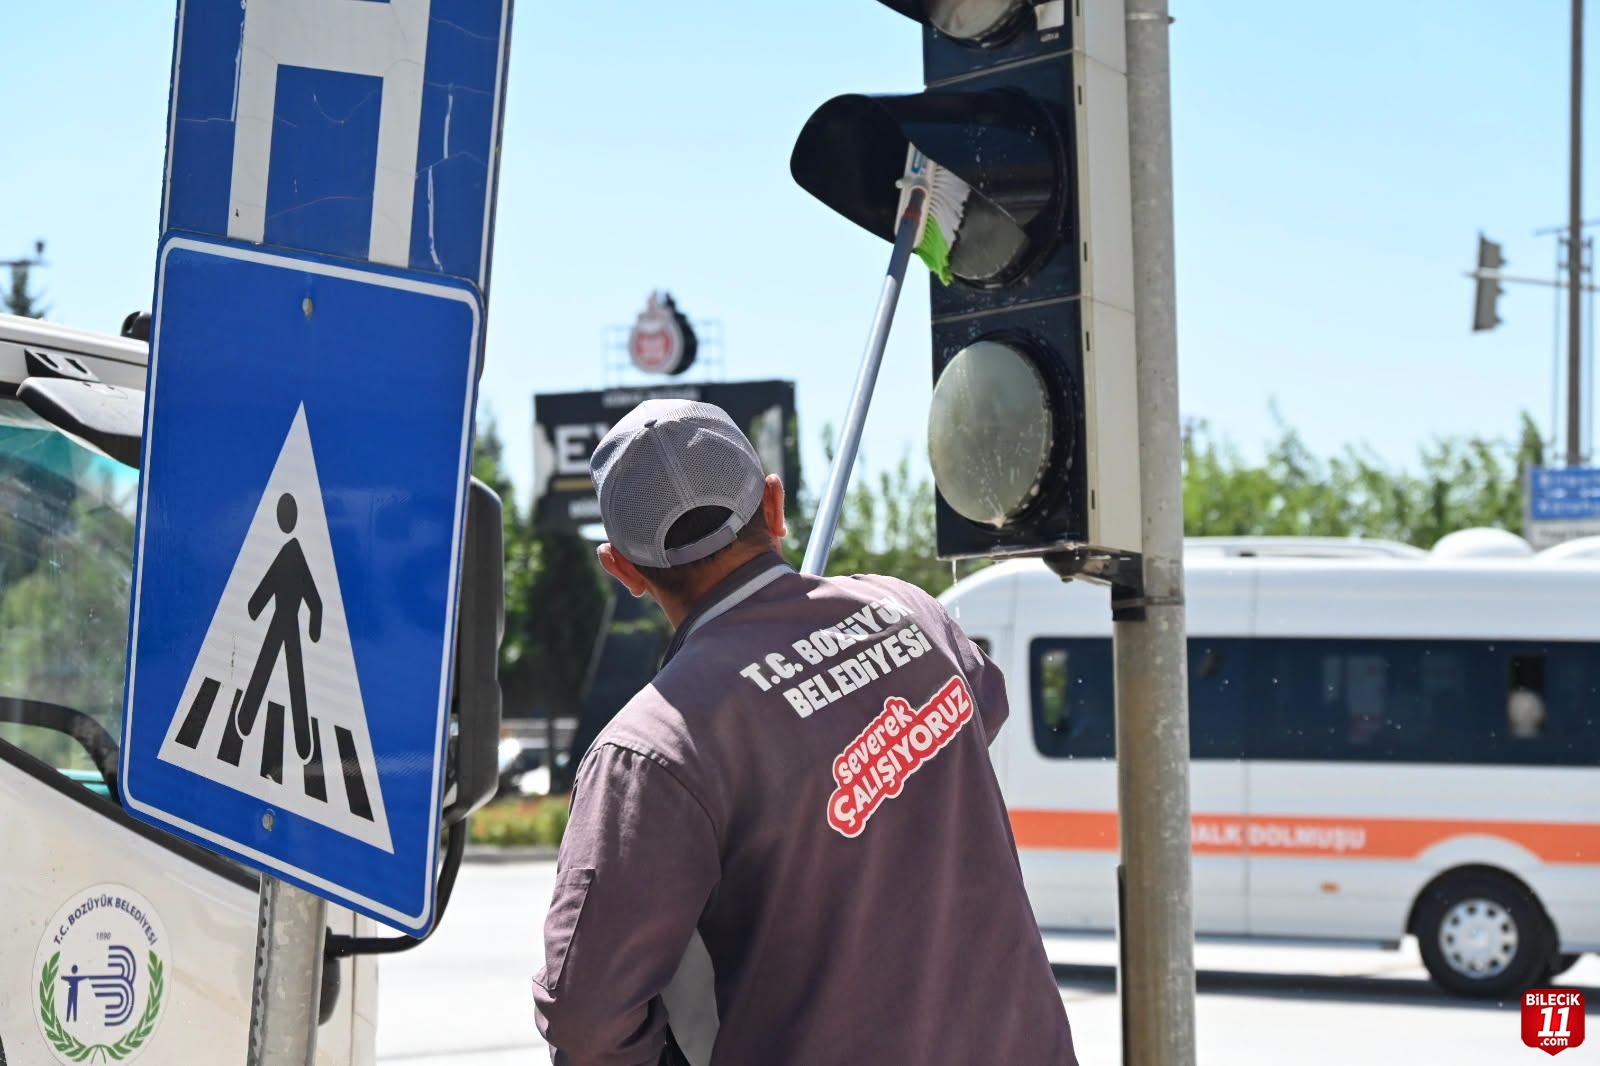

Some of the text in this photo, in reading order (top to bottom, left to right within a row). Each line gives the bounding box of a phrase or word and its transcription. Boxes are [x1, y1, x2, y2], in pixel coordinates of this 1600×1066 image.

[739, 652, 803, 692] T.C.
[833, 685, 970, 828] ÇALIŞIYORUZ
[837, 704, 913, 784] severek
[53, 893, 158, 946] T.C. BOZÜYÜK BELEDİYESİ
